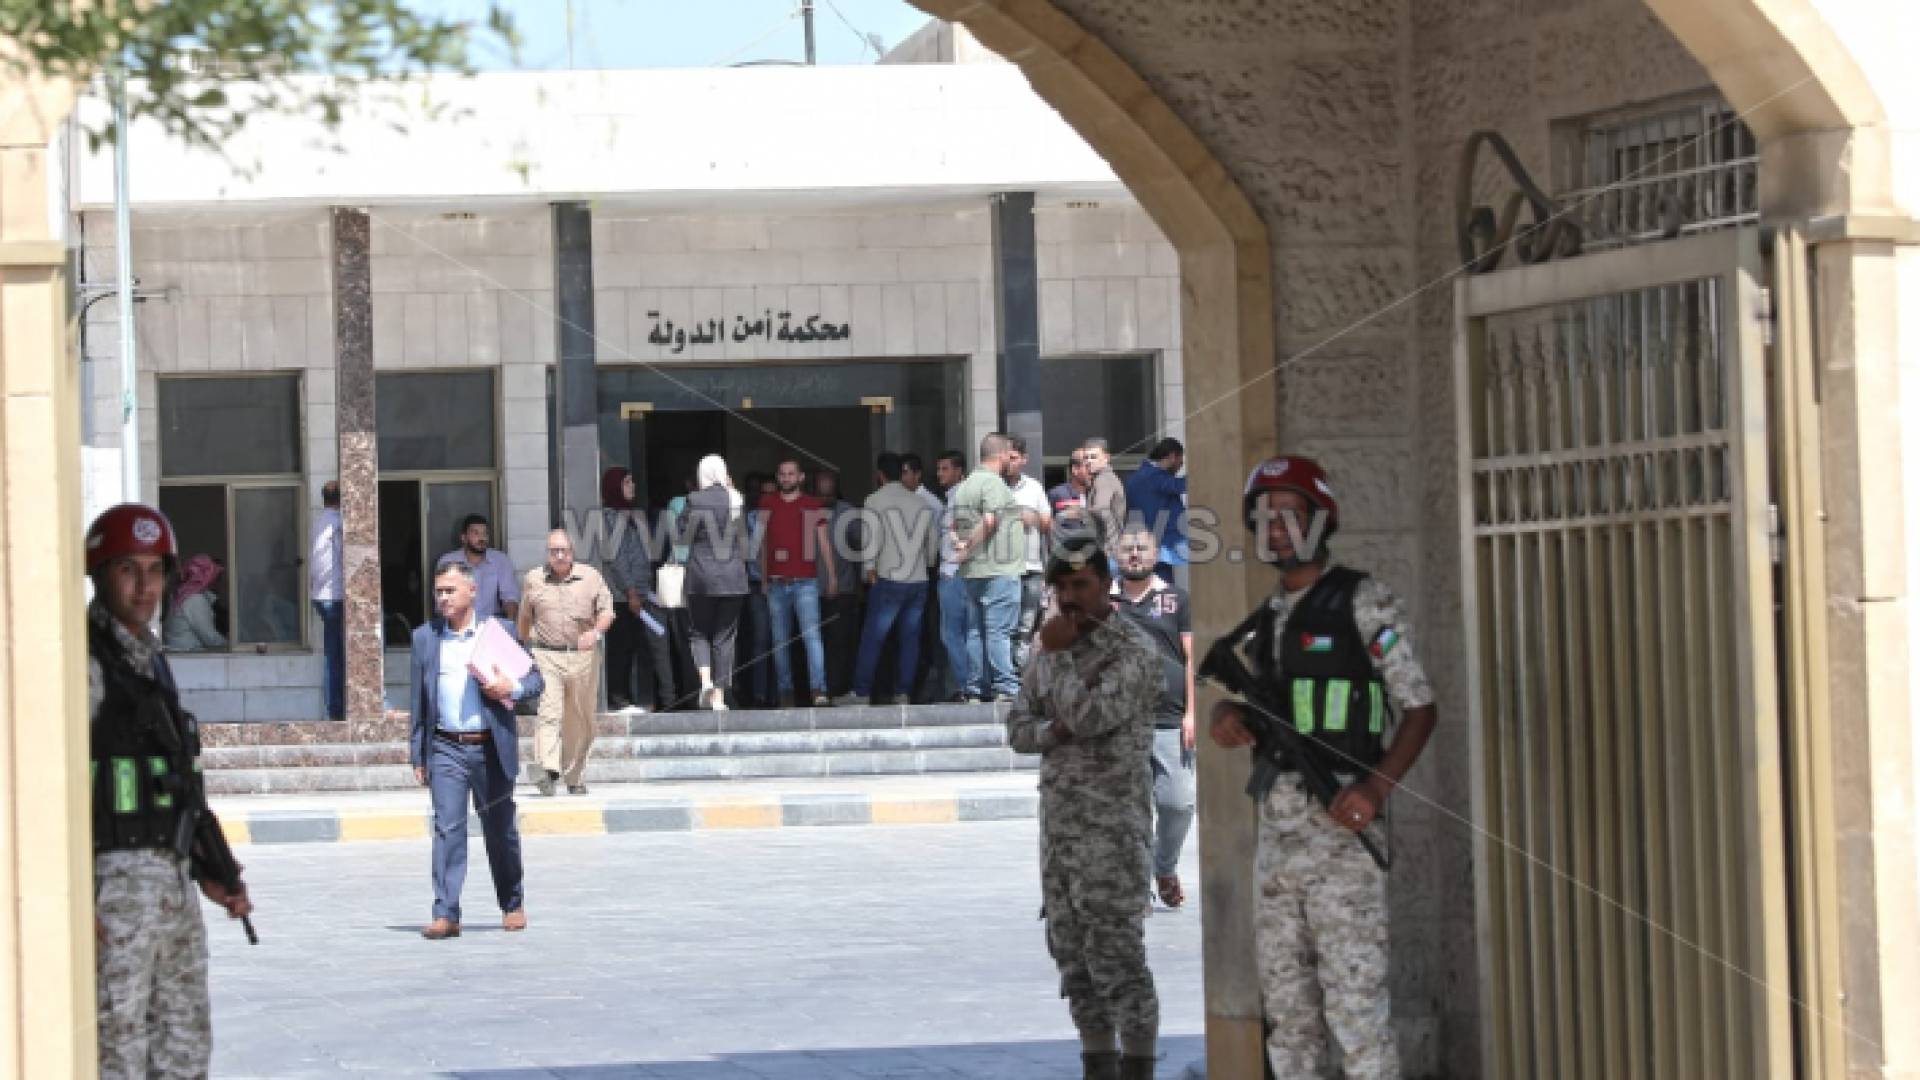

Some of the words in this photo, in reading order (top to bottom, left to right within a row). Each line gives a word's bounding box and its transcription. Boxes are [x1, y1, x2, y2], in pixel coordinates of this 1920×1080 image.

[647, 310, 724, 353] الدولة
[732, 308, 772, 342] أمن
[777, 310, 849, 342] محكمة
